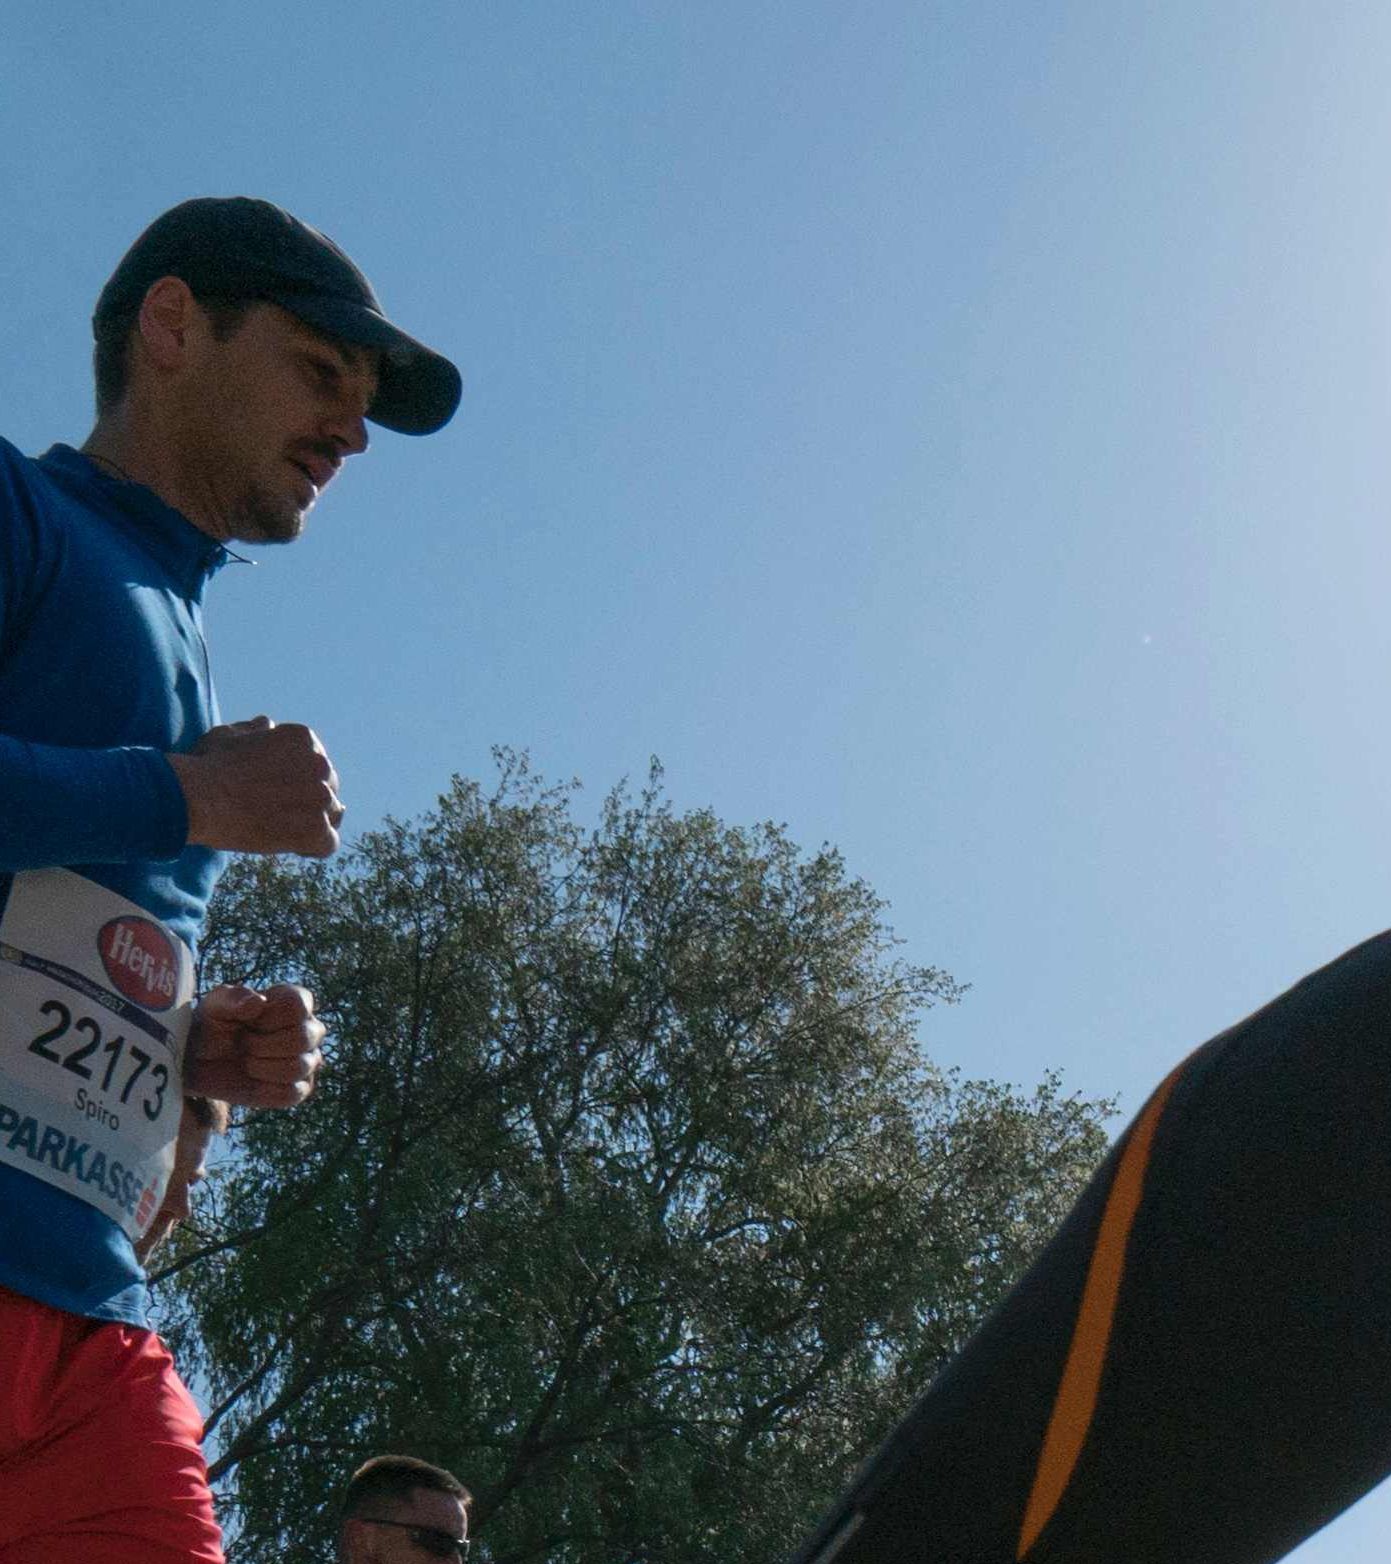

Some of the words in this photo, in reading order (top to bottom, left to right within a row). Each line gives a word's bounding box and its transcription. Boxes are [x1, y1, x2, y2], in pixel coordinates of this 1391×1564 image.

[109, 923, 176, 997] Hervis
[28, 1000, 168, 1121] 22173
[75, 1088, 120, 1131] Spiro
